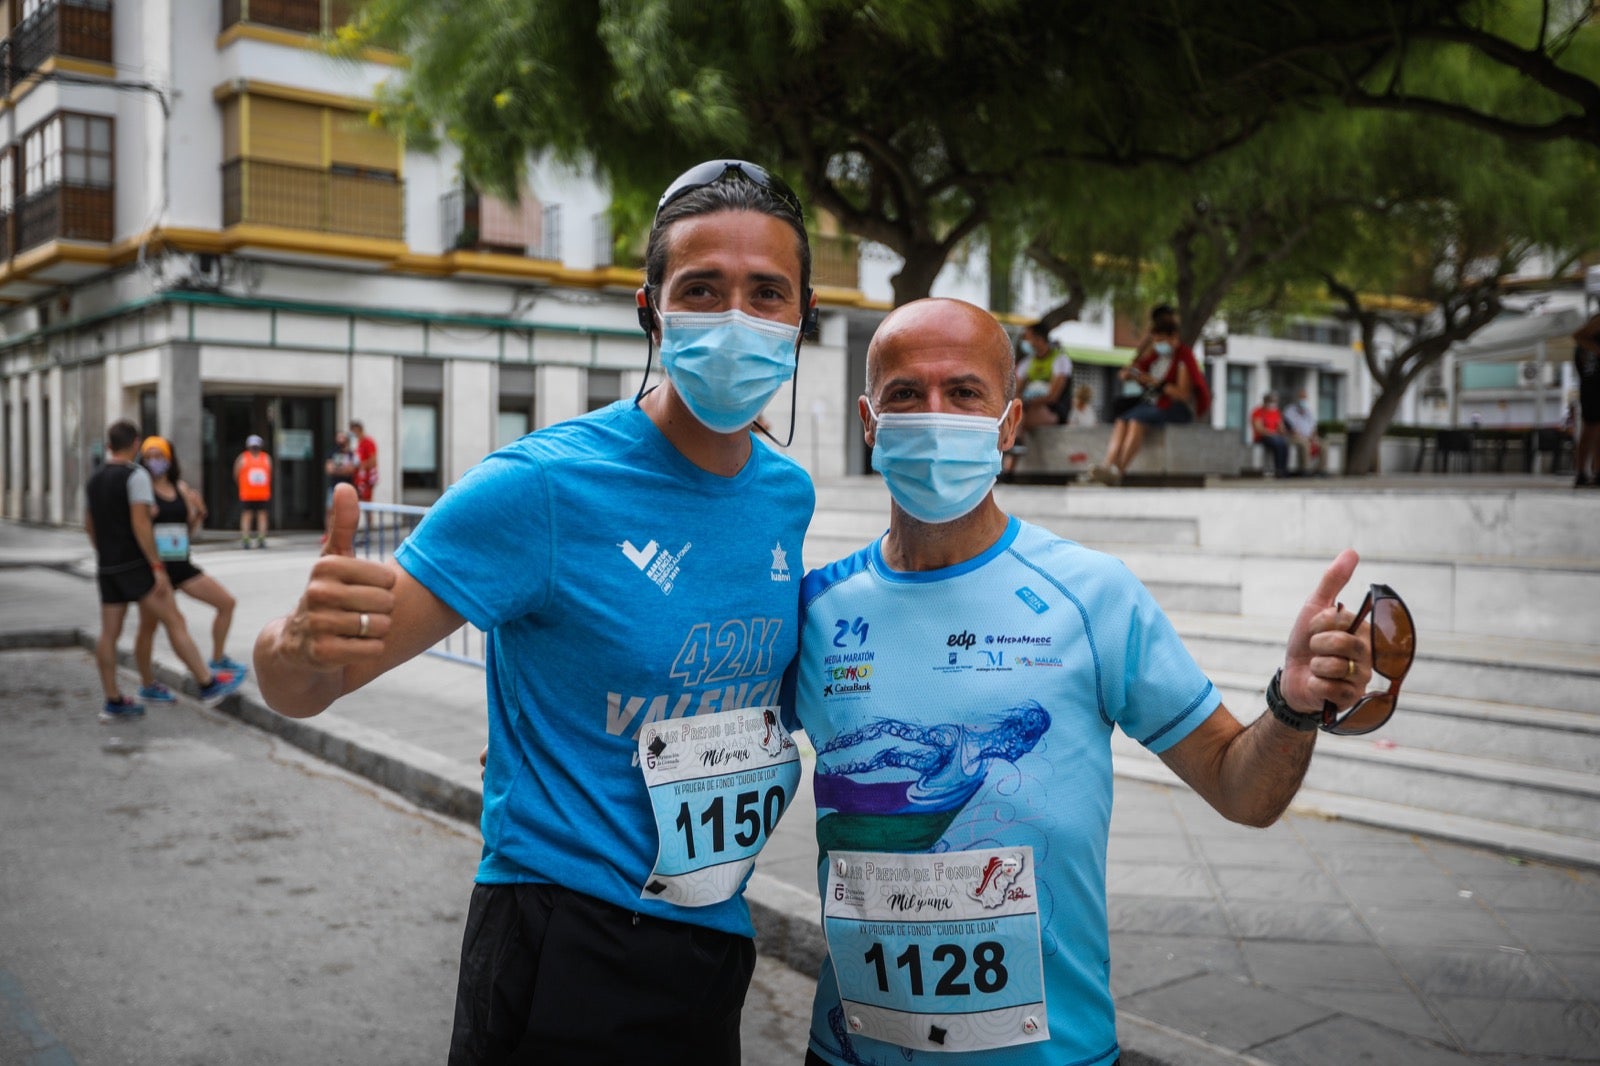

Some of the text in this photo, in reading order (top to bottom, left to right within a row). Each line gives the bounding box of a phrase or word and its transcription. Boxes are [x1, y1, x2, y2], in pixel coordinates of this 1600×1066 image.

[947, 630, 976, 650] edp
[669, 617, 783, 687] 42K
[835, 682, 872, 693] CaixaBank
[605, 678, 782, 740] VALENCI
[699, 748, 726, 767] Mil
[706, 779, 714, 791] DE
[676, 785, 785, 859] 1150
[880, 884, 960, 897] GRANADA
[887, 893, 916, 912] Mil
[868, 923, 896, 936] PRUEBA
[897, 924, 906, 936] DE
[907, 924, 932, 936] FONDO
[965, 922, 976, 935] DE
[864, 941, 1008, 996] 1128
